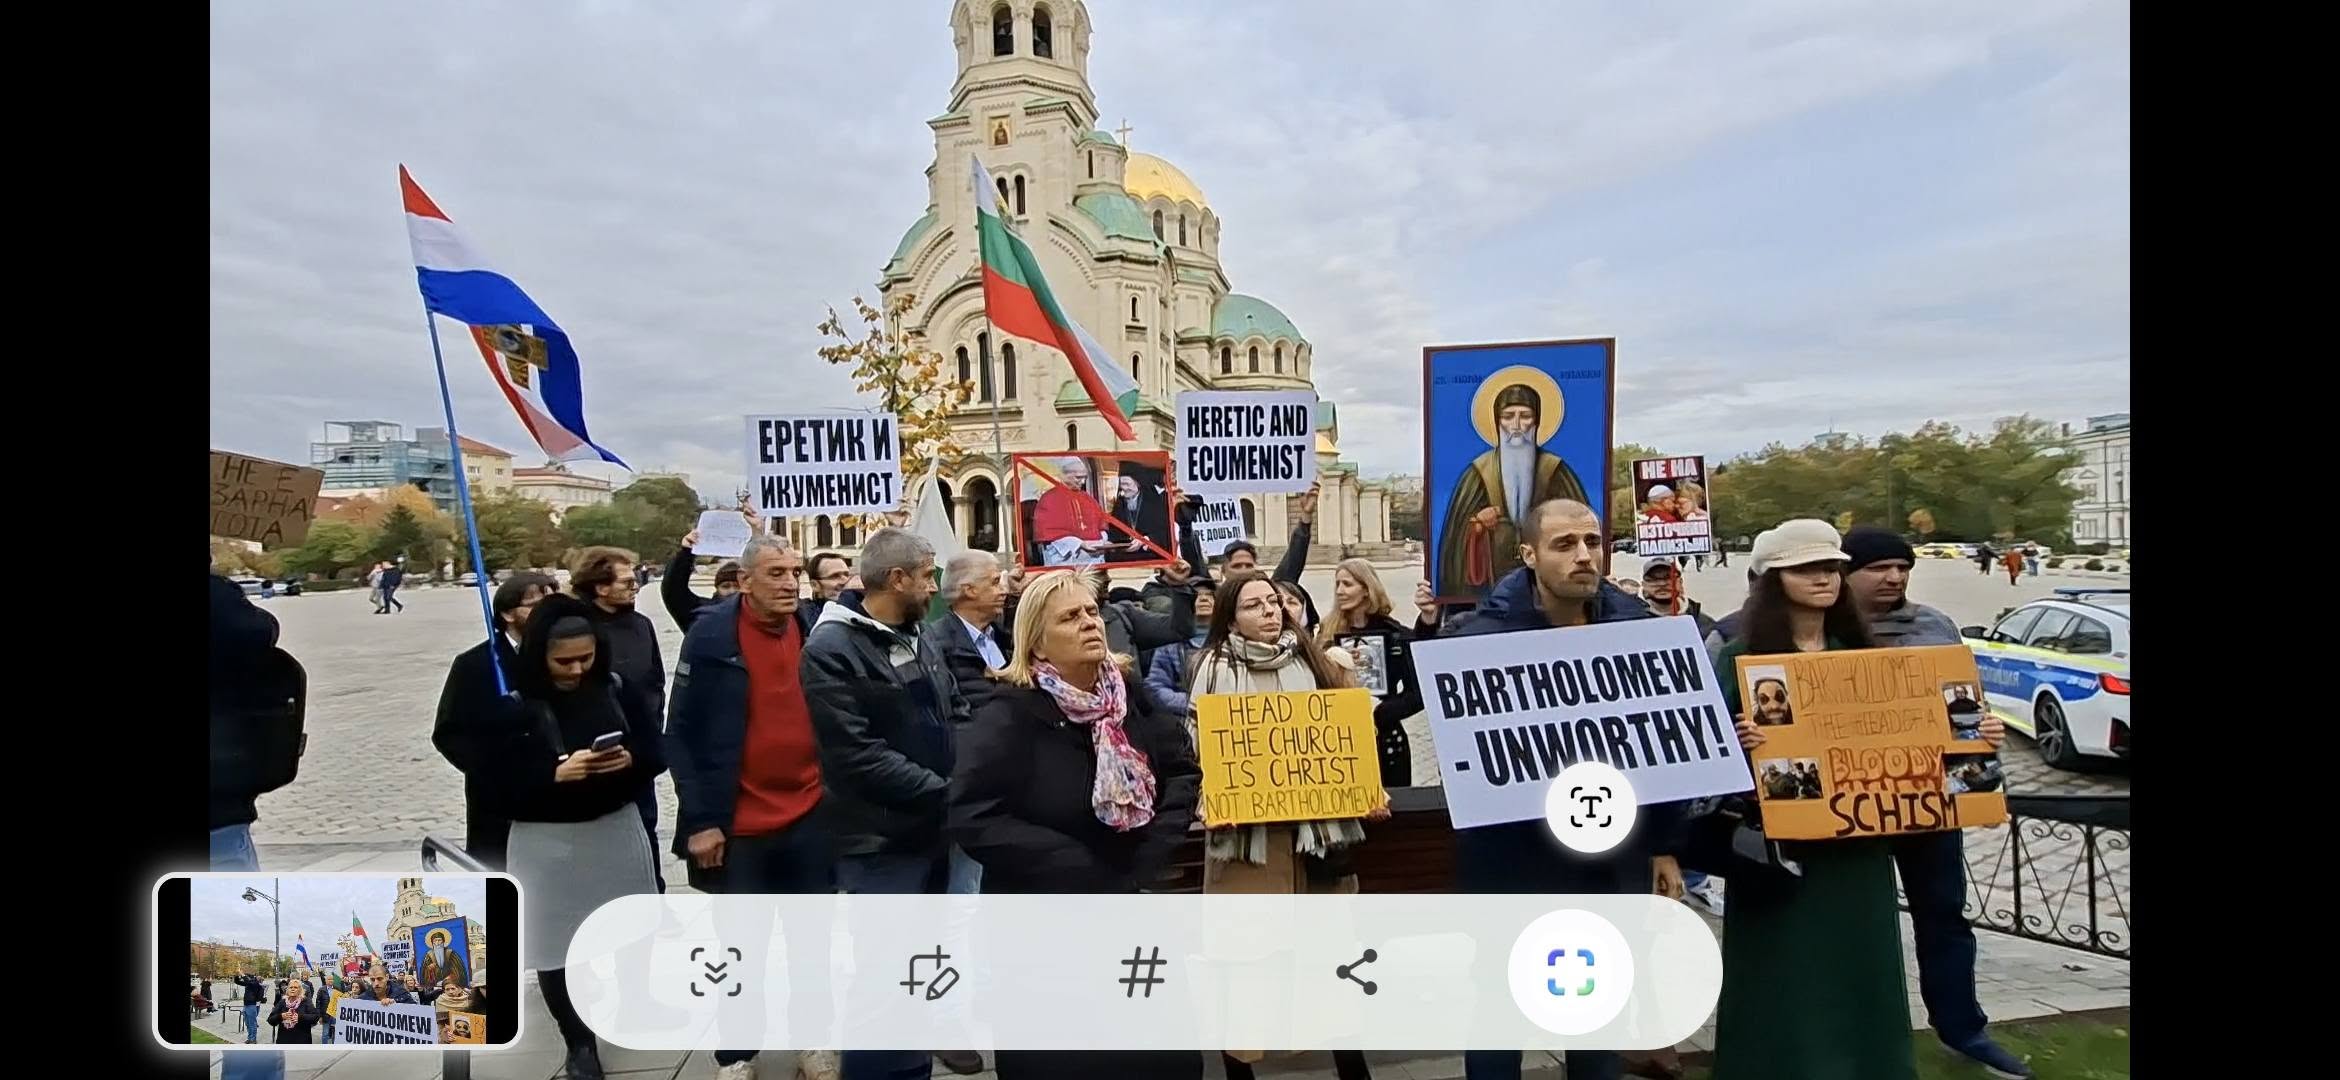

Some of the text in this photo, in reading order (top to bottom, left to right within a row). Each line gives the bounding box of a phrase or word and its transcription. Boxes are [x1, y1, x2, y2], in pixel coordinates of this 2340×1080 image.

[1187, 404, 1308, 438] HERETIC AND
[758, 418, 892, 464] ЕРЕТИК И
[222, 455, 300, 494] НЕ Е
[1188, 444, 1306, 482] ECUMENIST
[1641, 458, 1698, 479] НЕ НА
[760, 472, 893, 510] ИКУМЕНИСТ
[1434, 646, 1705, 720] BARTHOLOMEW
[1228, 693, 1336, 726] HEAD OF
[1211, 725, 1354, 758] THE CHURCH
[1474, 704, 1731, 787] UNWORTHY!
[1222, 756, 1359, 790] IS CHRIST
[1828, 744, 1946, 788] BLOODY
[1205, 784, 1383, 820] NOT BARTHOLOMEW
[1829, 791, 1959, 837] SCHISM
[340, 1006, 432, 1036] BARTHOLOMEW
